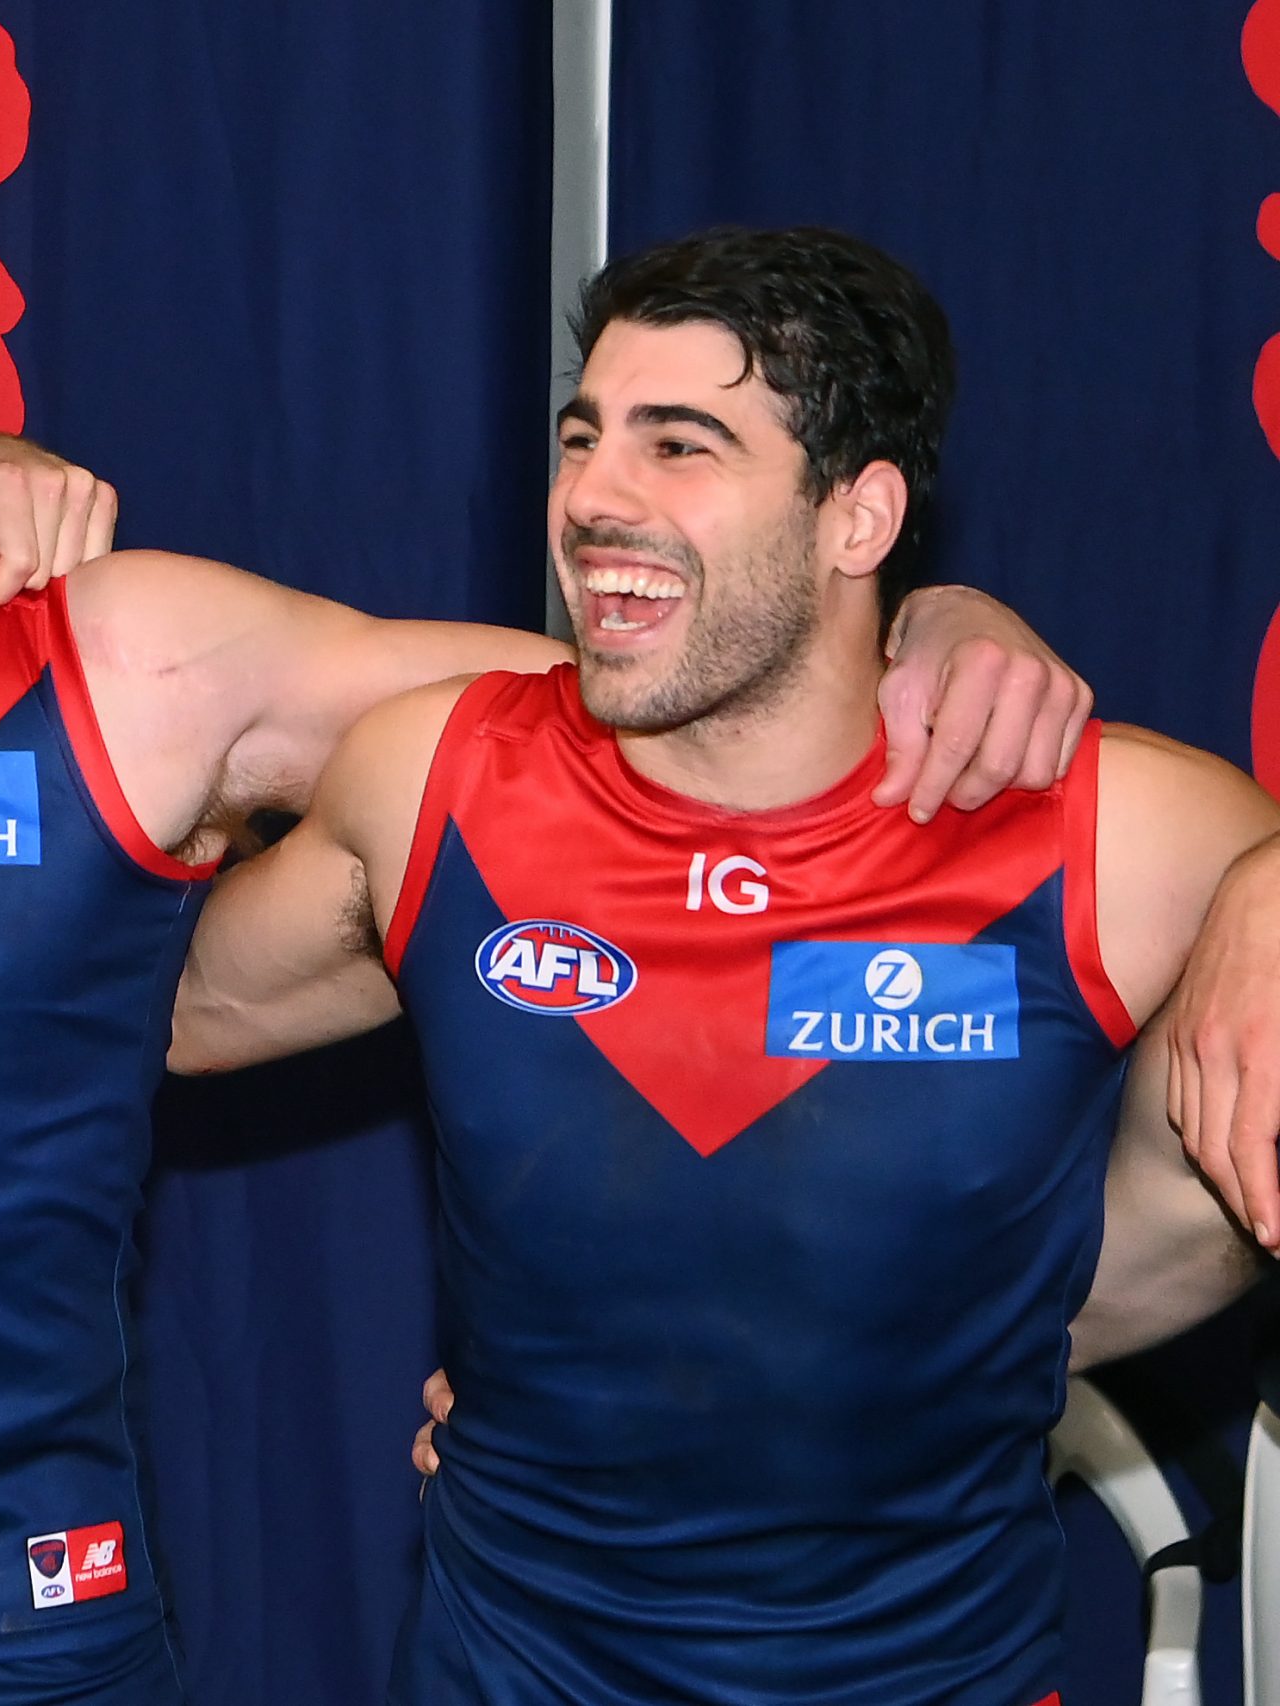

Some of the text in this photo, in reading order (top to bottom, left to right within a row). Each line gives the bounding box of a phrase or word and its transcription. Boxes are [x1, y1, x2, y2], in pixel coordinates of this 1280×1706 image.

[685, 852, 770, 915] IG
[486, 937, 618, 997] AFL
[788, 1010, 995, 1053] ZURICH
[75, 1563, 122, 1582] new balance
[81, 1539, 117, 1570] NB
[43, 1586, 64, 1598] AFL
